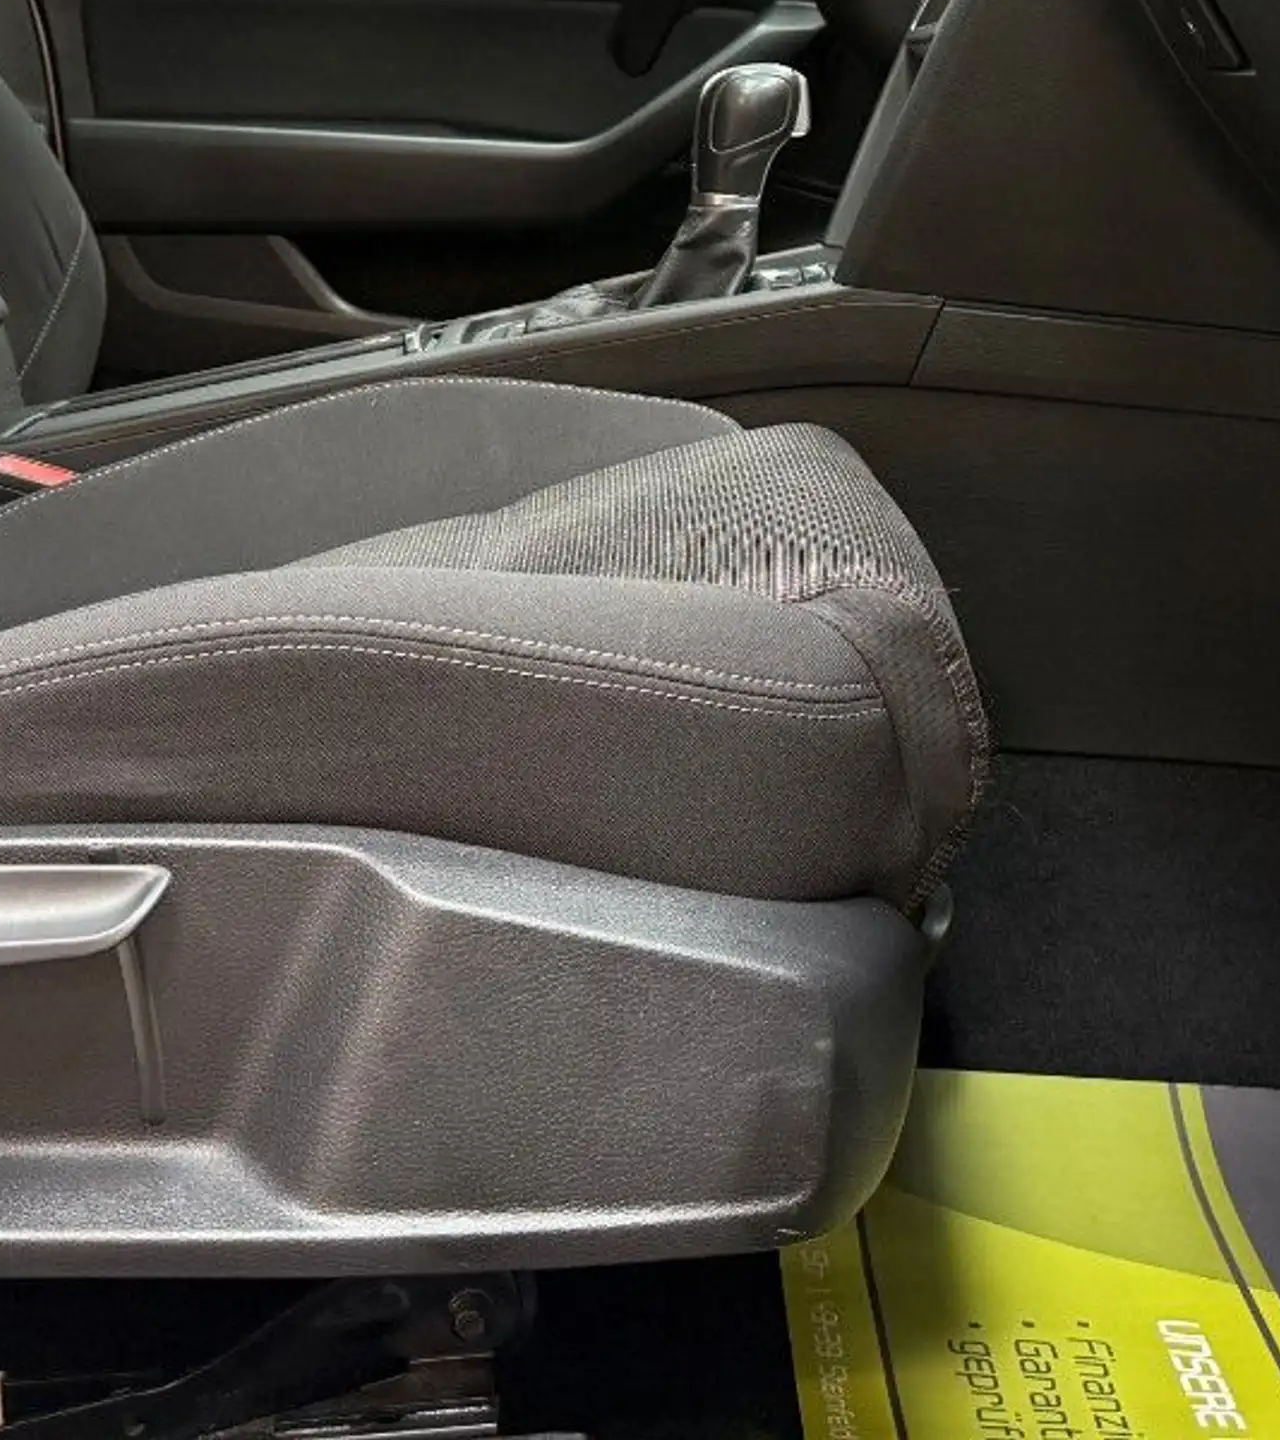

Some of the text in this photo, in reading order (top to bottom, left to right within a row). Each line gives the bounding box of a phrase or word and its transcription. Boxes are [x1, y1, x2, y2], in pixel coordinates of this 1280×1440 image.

[947, 1338, 1026, 1440] geprüf
[1014, 1338, 1083, 1440] Garant
[1066, 1336, 1146, 1440] Finanzi
[1157, 1319, 1248, 1431] UNSERE
